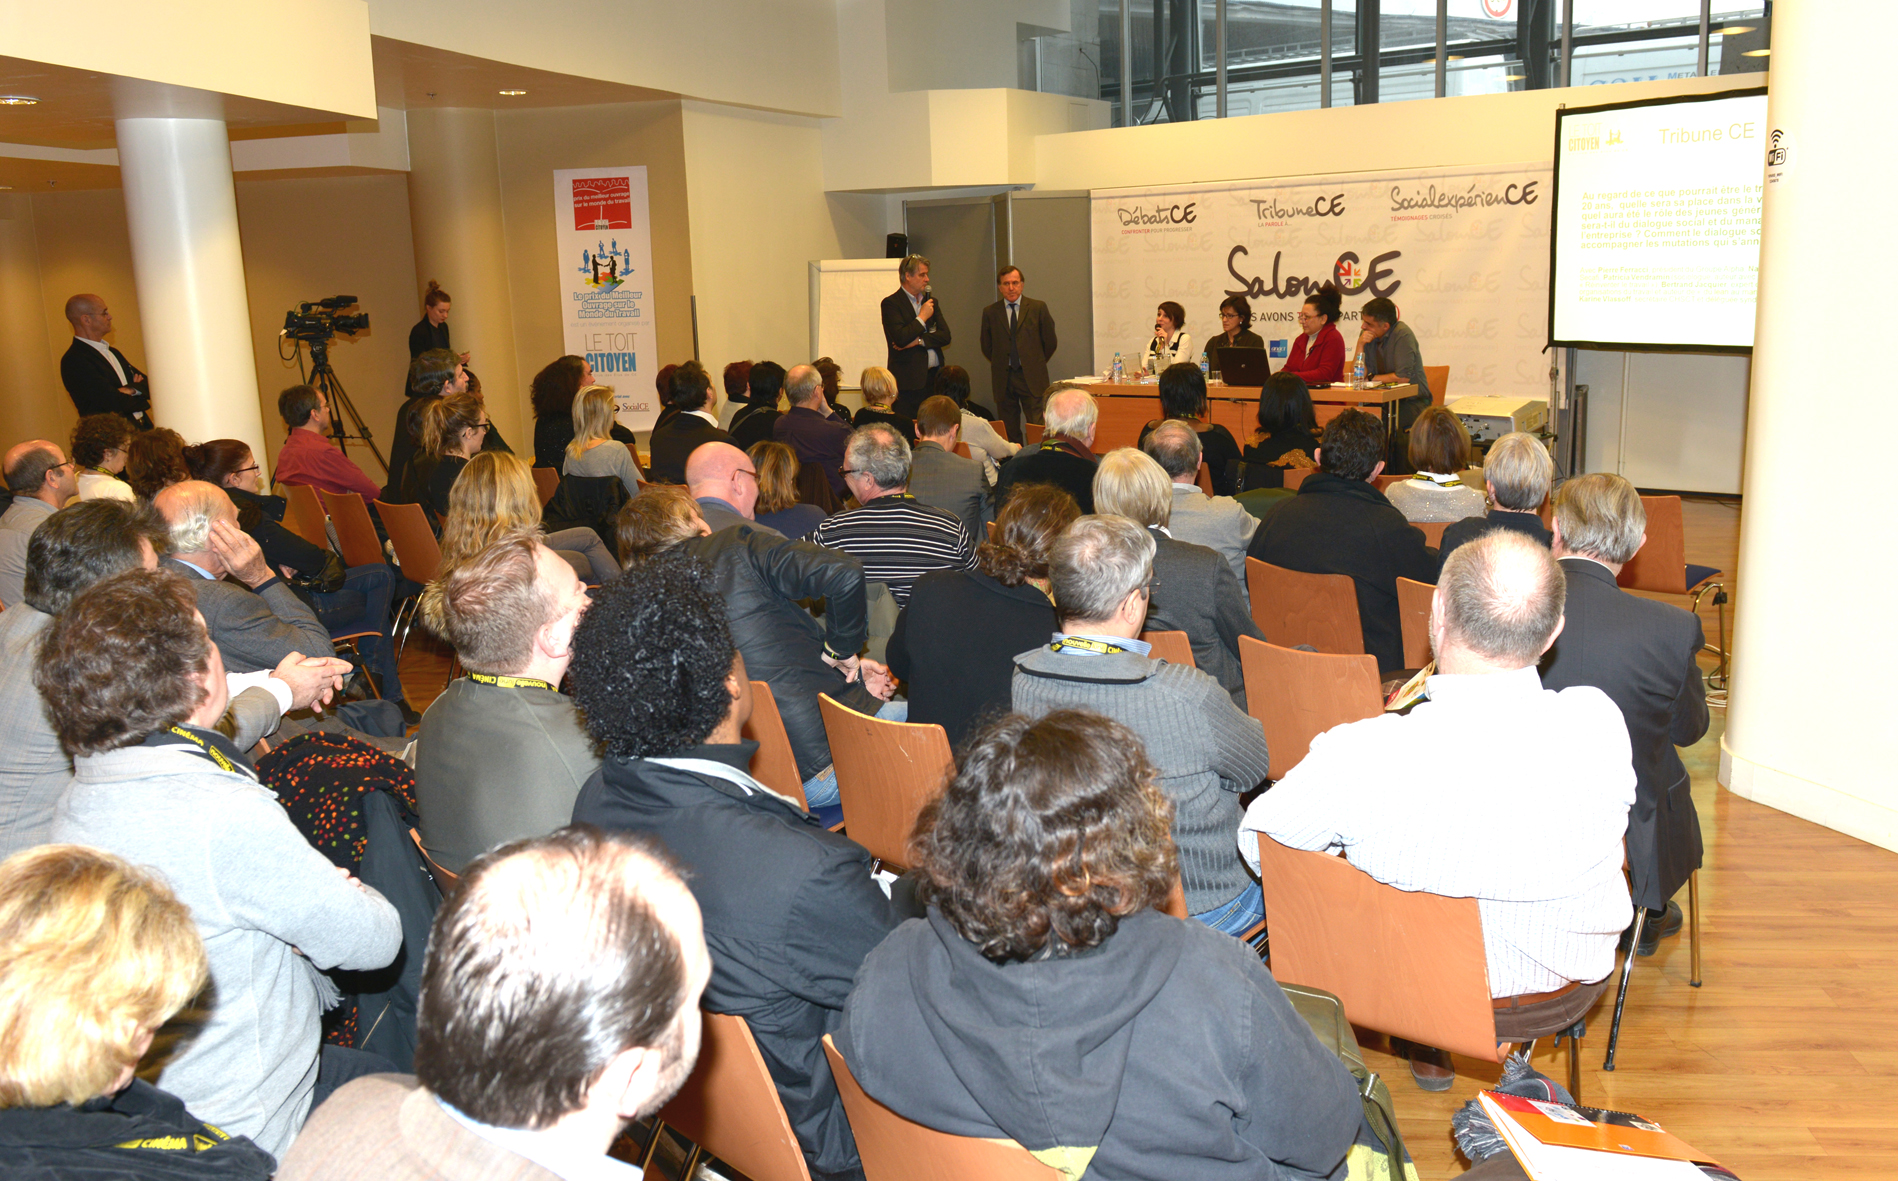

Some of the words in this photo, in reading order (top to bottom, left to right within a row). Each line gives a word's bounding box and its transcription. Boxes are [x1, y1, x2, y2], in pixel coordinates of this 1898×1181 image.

[1659, 127, 1722, 144] Tribune
[1729, 122, 1755, 139] CE
[1569, 136, 1600, 151] CITOYEN
[1582, 192, 1594, 200] Au
[1598, 190, 1628, 201] regard
[1630, 190, 1641, 198] de
[1658, 190, 1675, 198] que
[1679, 186, 1718, 198] pourrait
[1721, 185, 1740, 194] être
[1744, 185, 1751, 193] le
[1582, 202, 1592, 210] 20
[1619, 200, 1647, 210] quelle
[1688, 197, 1714, 208] place
[1717, 196, 1741, 204] dans
[1745, 195, 1753, 203] la
[1582, 211, 1600, 221] quel
[1627, 210, 1640, 218] été
[1644, 209, 1651, 217] le
[1655, 209, 1673, 217] rôle
[1676, 208, 1692, 216] des
[1695, 208, 1728, 218] jeunes
[1581, 220, 1615, 229] sera-t-il
[1618, 220, 1630, 228] du
[1633, 220, 1673, 229] dialogue
[1676, 218, 1705, 227] social
[1720, 217, 1732, 225] du
[1581, 230, 1632, 240] l'entreprise
[1644, 229, 1690, 238] Comment
[1693, 228, 1701, 236] le
[1704, 228, 1746, 238] dialogue
[1581, 241, 1643, 250] accompagner
[1662, 238, 1709, 247] mutations
[1714, 238, 1728, 247] qui
[1225, 245, 1401, 299] SalonCE
[573, 292, 583, 300] Le
[584, 292, 600, 302] prix
[600, 291, 611, 300] du
[612, 290, 642, 299] Meilleur
[582, 301, 612, 310] Ouvrage
[627, 300, 635, 308] le
[578, 310, 603, 318] Monde
[604, 310, 614, 318] du
[614, 309, 640, 317] Travail
[1260, 312, 1294, 322] AVONS
[585, 334, 602, 351] LE
[605, 332, 637, 351] TOIT
[586, 352, 636, 372] CITOYEN
[472, 674, 496, 684] CINÉMA
[171, 726, 204, 746] CINÉMA
